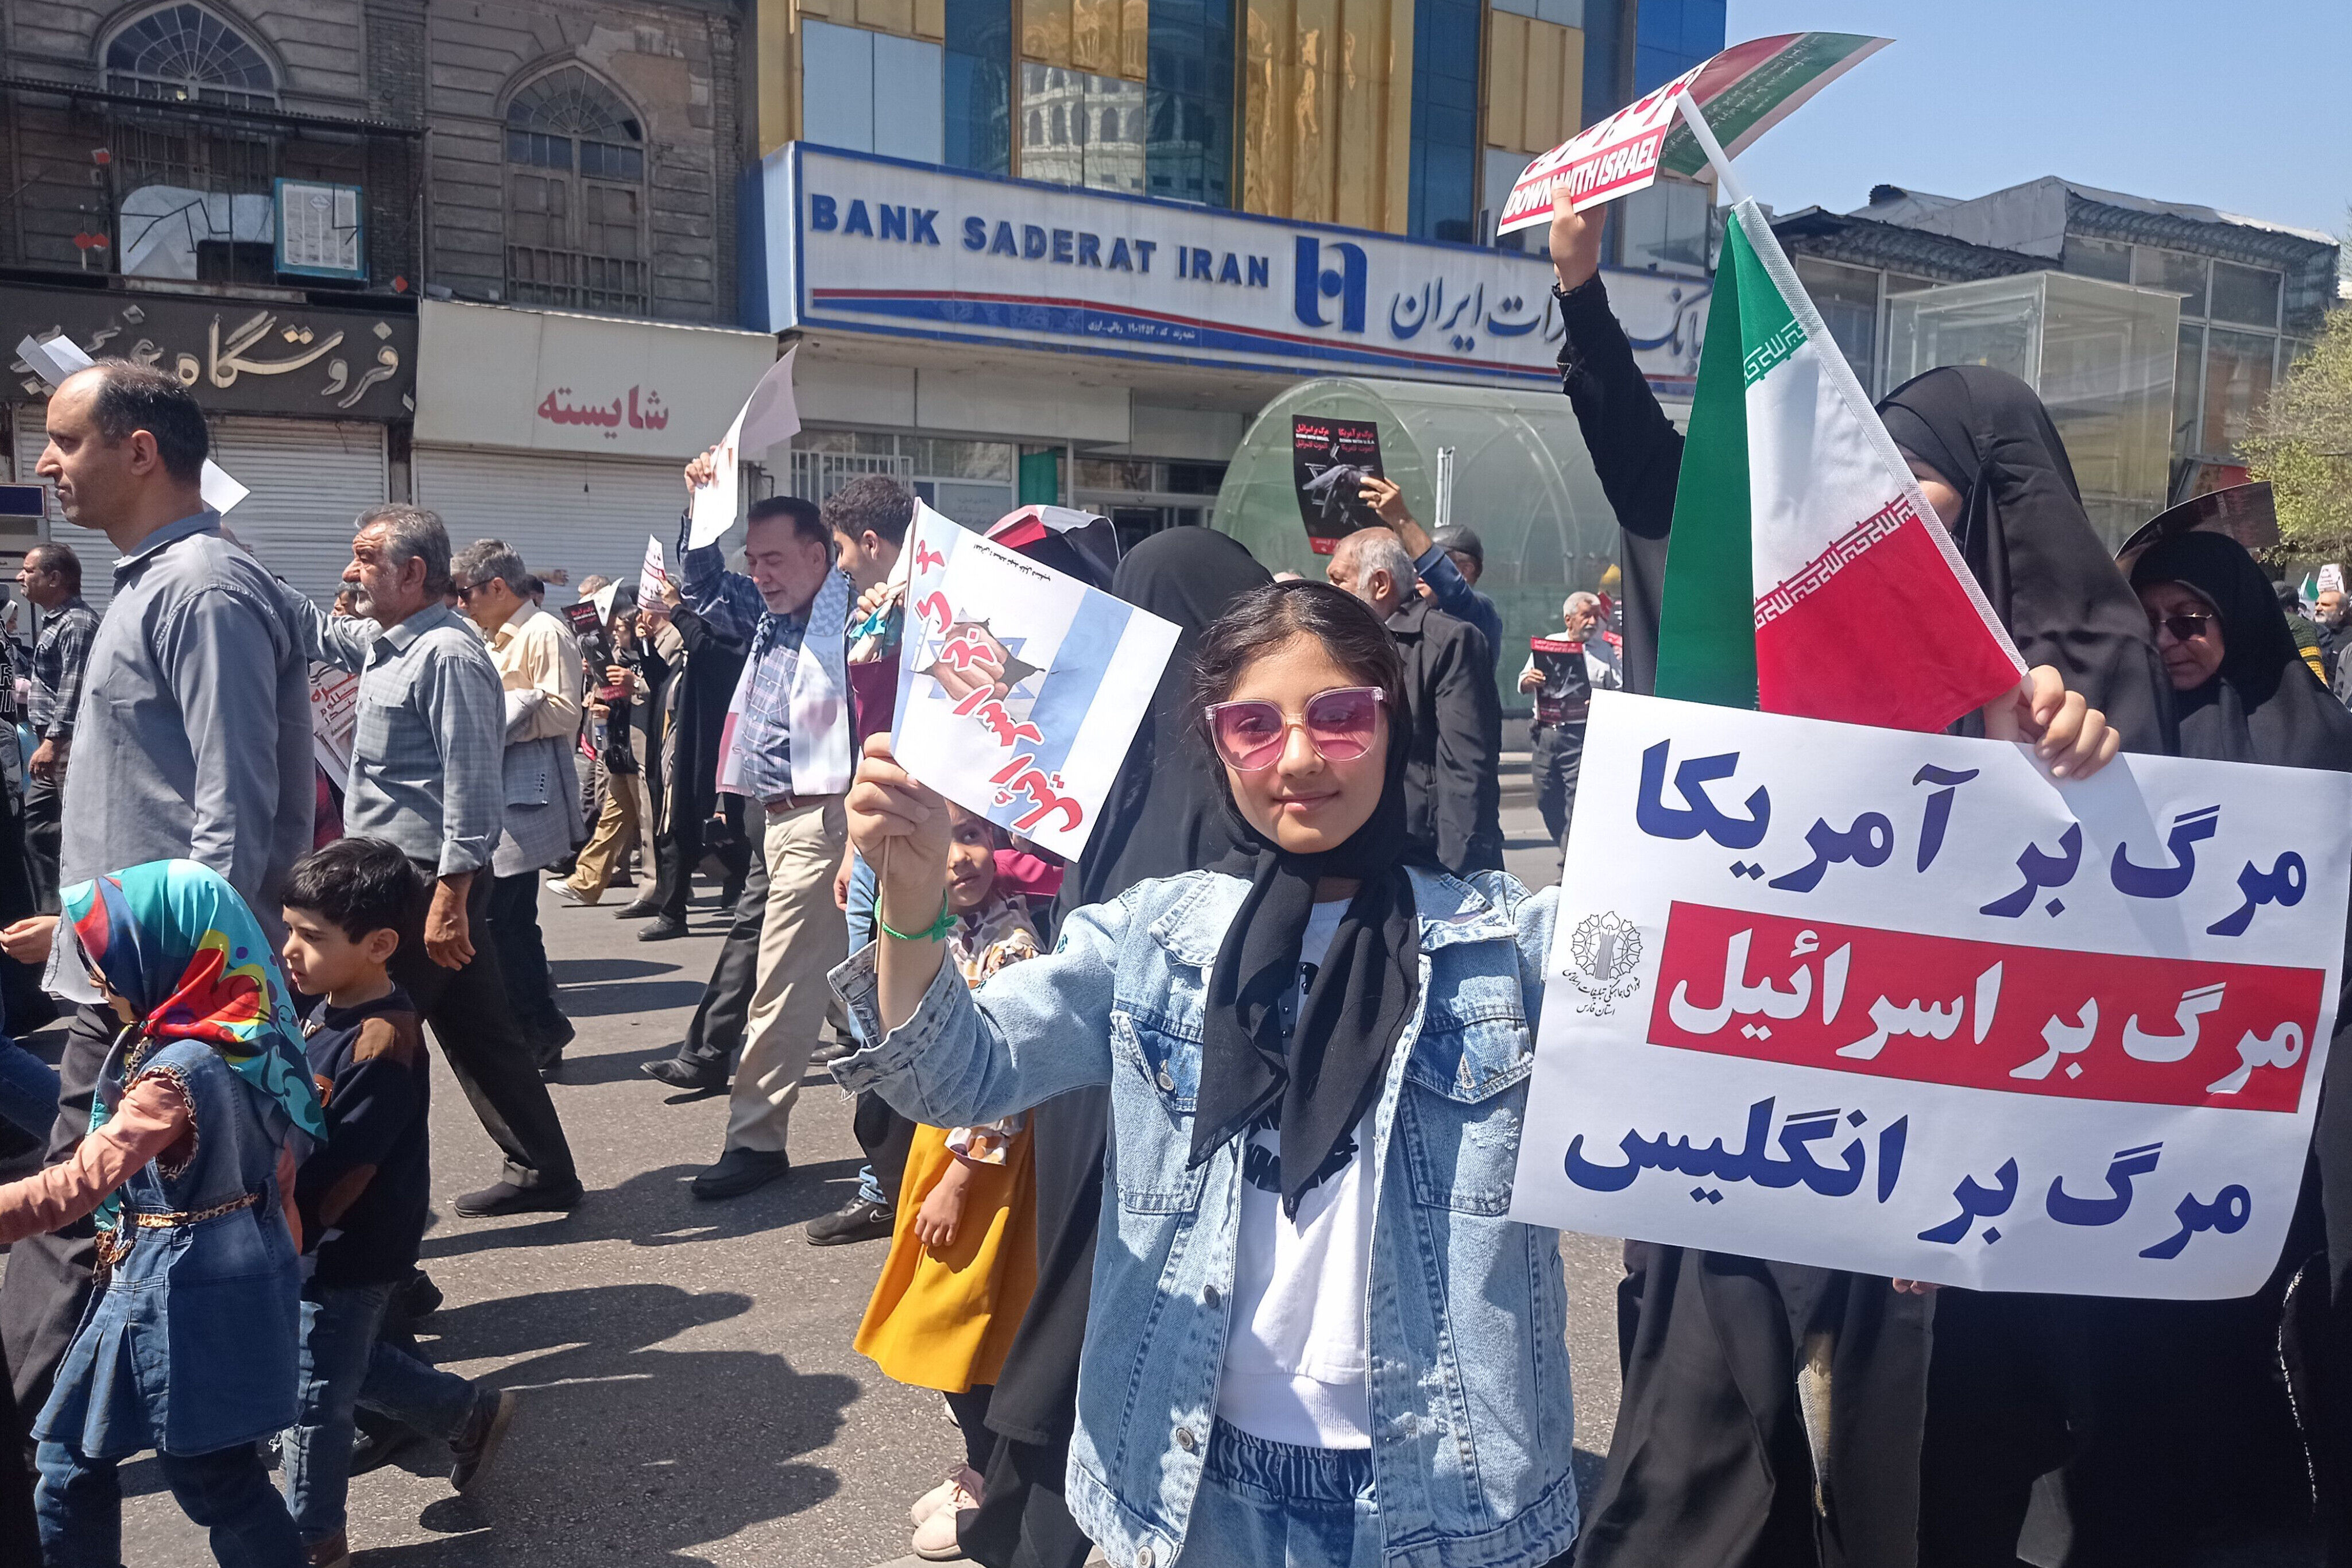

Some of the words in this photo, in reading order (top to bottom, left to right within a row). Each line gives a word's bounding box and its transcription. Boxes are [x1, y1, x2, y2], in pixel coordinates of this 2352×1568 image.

[1504, 176, 1553, 219] DOWN
[1596, 135, 1659, 188] ISRAEL
[810, 193, 941, 246] BANK
[962, 215, 1156, 273] SADERAT
[1177, 245, 1269, 288] IRAN
[1390, 276, 1484, 352] ایران
[537, 384, 669, 439] شایسته
[942, 631, 994, 669] بر
[953, 687, 1083, 833] اسرائیل
[1636, 740, 1979, 893] آمریکا
[1980, 822, 2083, 919] بر
[2111, 805, 2307, 936] مرگ
[1576, 1001, 1596, 1013] فارس
[1595, 1004, 1616, 1017] استان
[1668, 927, 2003, 1062] اسرائیل
[2009, 996, 2099, 1081] بر
[2121, 982, 2305, 1095] مرگ
[1564, 1096, 1908, 1206] انگلیس
[1917, 1156, 2019, 1246] بر
[2045, 1141, 2252, 1260] مرگ
